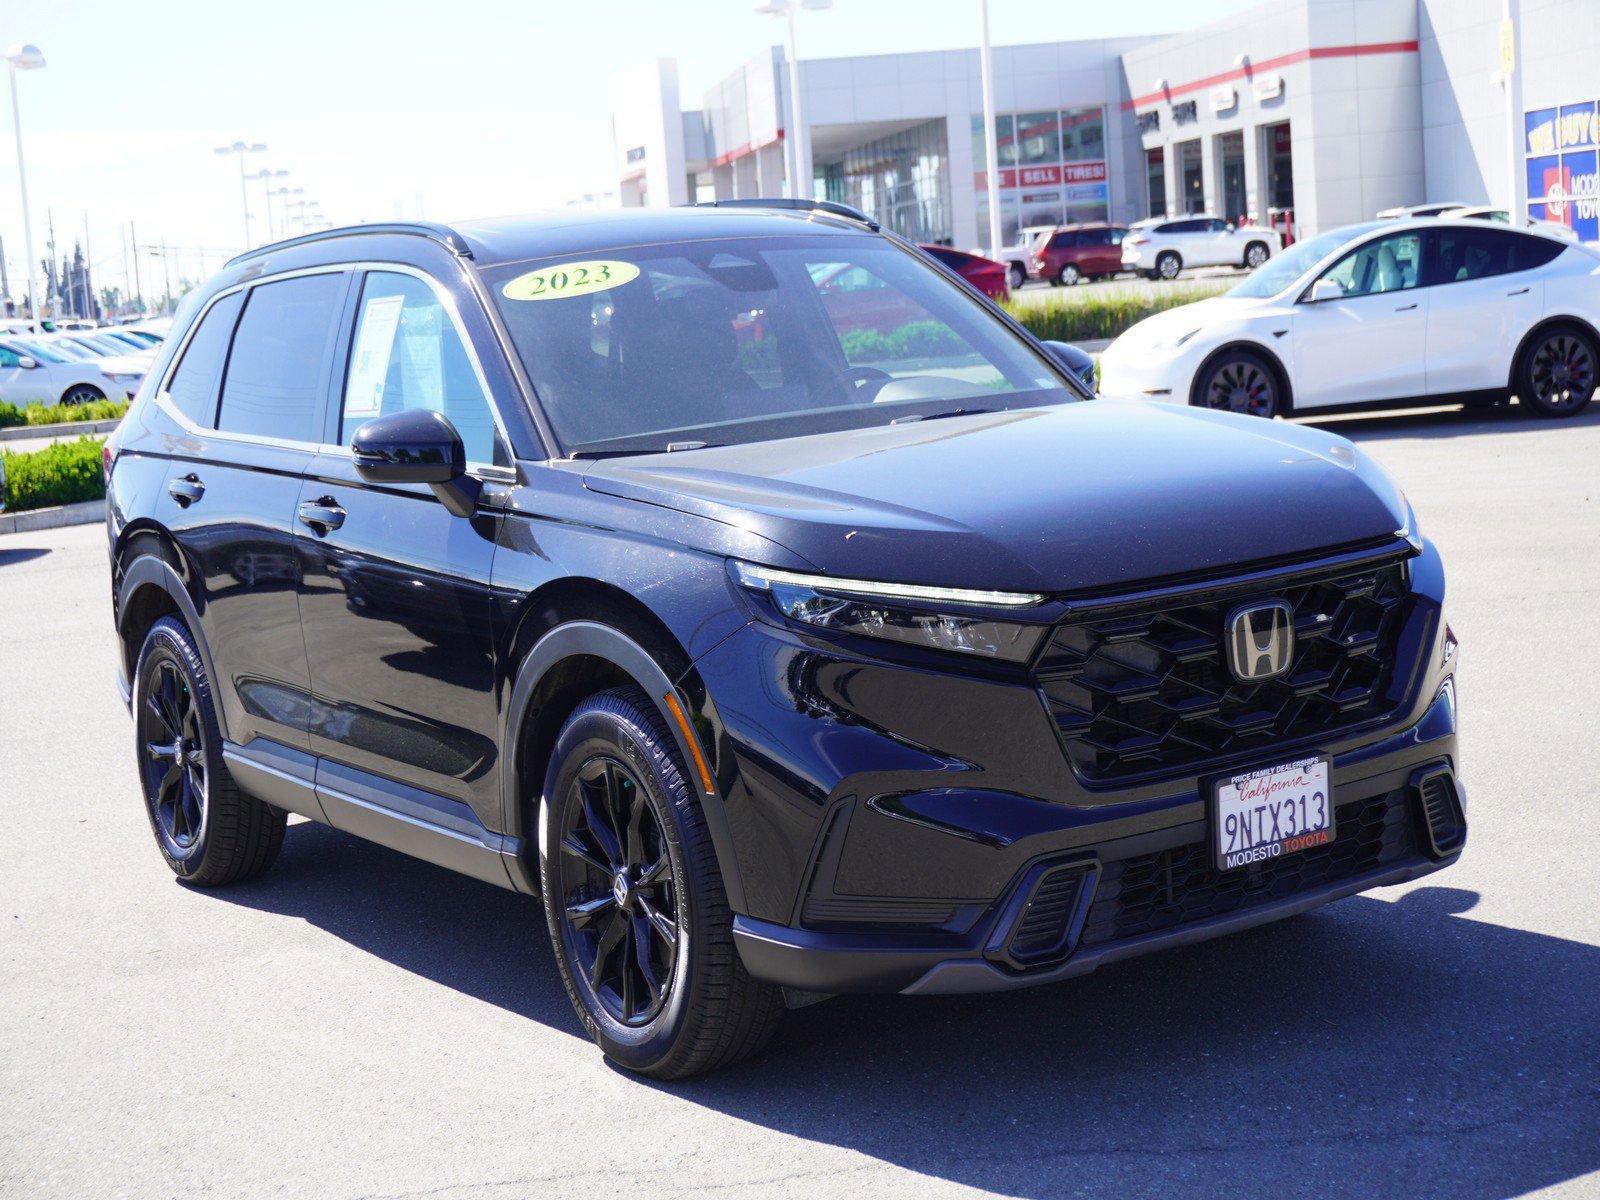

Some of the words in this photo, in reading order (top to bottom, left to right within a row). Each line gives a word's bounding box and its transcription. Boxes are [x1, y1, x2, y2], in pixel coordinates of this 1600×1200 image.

[1528, 120, 1554, 154] WE
[1555, 112, 1591, 148] BUY
[1023, 168, 1056, 184] SELL
[528, 264, 611, 296] 2023
[1231, 773, 1251, 784] PRICE
[1252, 767, 1276, 780] FAMILY
[1276, 756, 1319, 774] DEALERSHIPS
[1239, 774, 1311, 802] California
[1226, 843, 1281, 869] MODESTO
[1283, 831, 1329, 853] TOYOTA
